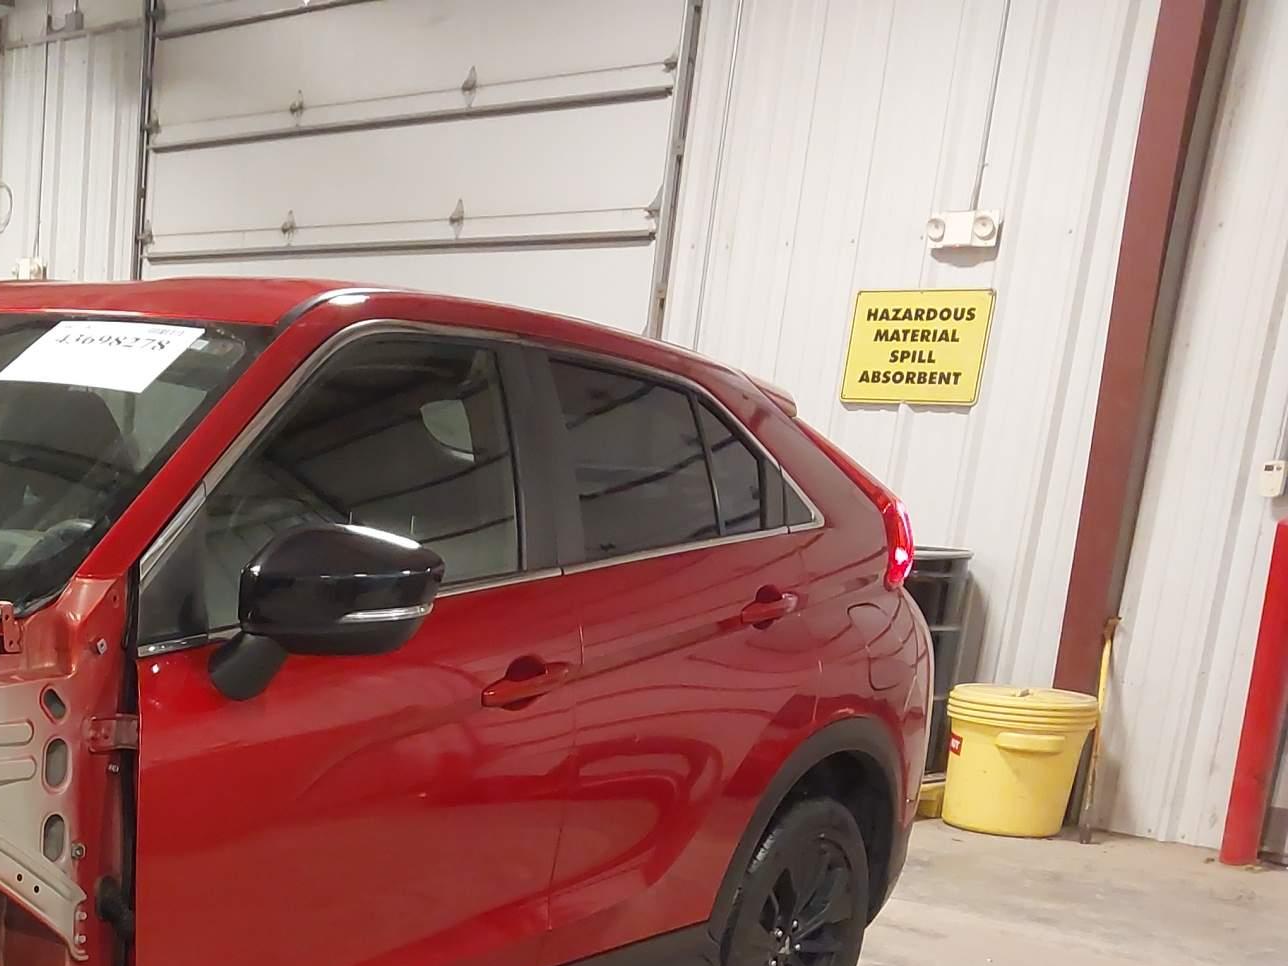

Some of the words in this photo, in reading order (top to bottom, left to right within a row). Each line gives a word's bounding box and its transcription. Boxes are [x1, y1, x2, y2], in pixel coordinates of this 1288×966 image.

[866, 307, 977, 322] HAZARDOUS
[873, 328, 960, 343] MATERIAL
[888, 349, 936, 364] SPILL
[858, 370, 963, 386] ABSORBENT
